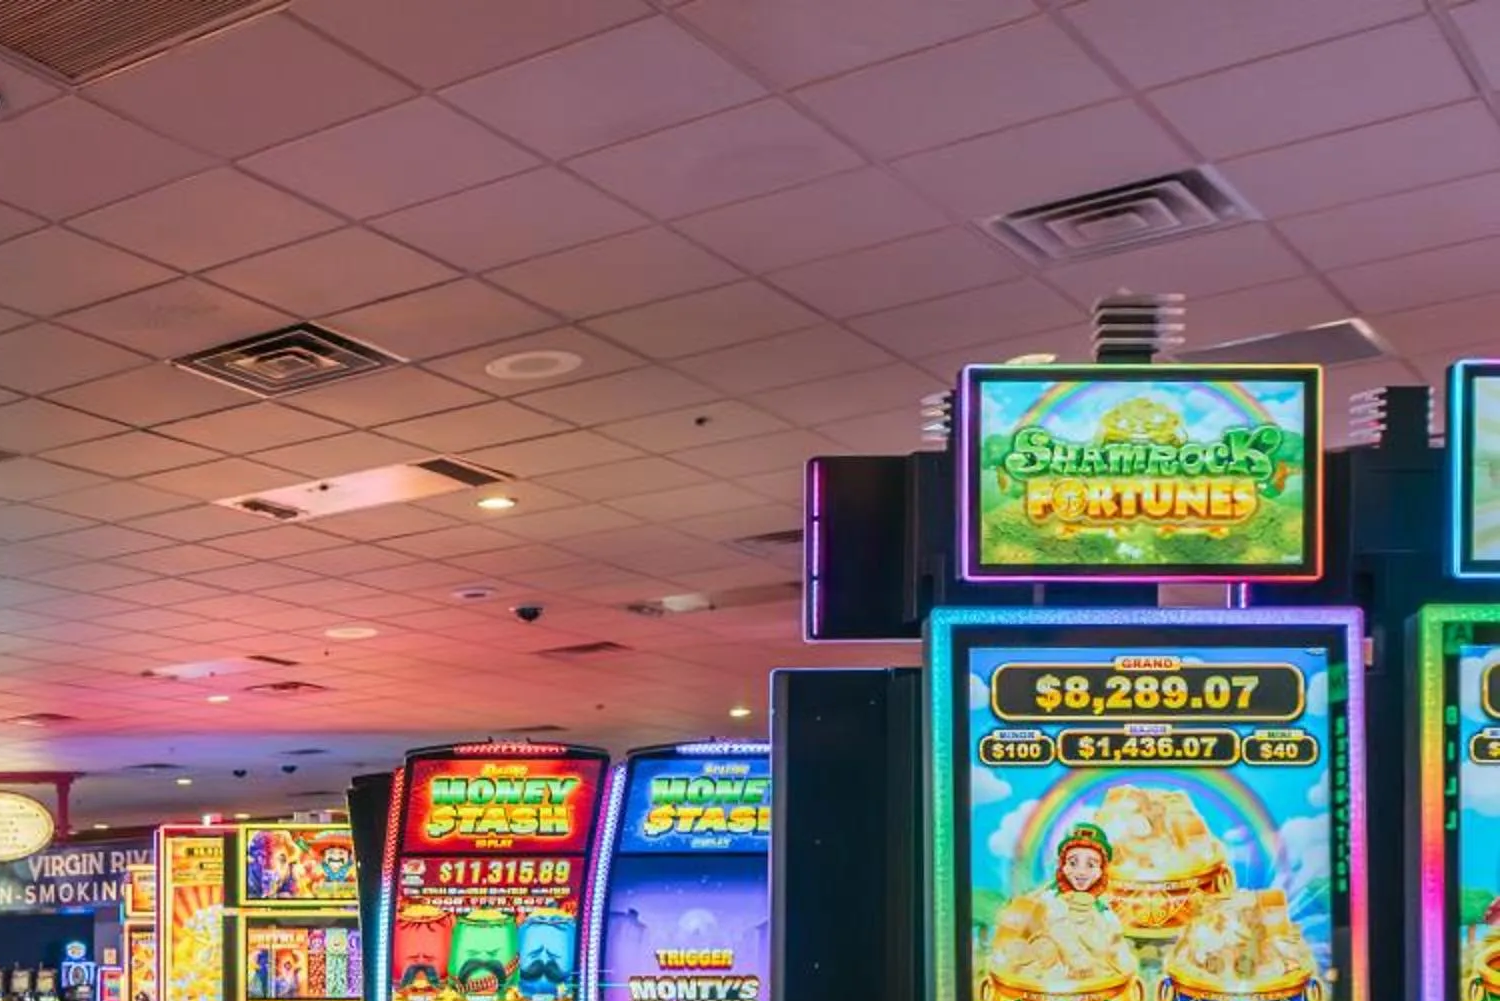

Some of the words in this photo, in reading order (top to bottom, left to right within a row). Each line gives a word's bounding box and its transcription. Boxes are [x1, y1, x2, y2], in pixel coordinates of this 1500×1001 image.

[1005, 426, 1283, 481] SHAMROCK
[1027, 477, 1258, 523] FORTUNES
[1121, 660, 1173, 669] GRAND
[1035, 674, 1259, 713] $8,289.07
[992, 741, 1041, 761] $100
[1078, 737, 1218, 762] $1,436.07
[1260, 742, 1298, 760] $40
[432, 777, 579, 805] MONEY
[650, 776, 771, 805] MONE
[28, 851, 104, 881] VIRGIN
[656, 950, 733, 969] TRIGGER
[629, 977, 760, 1001] MONTY'S
